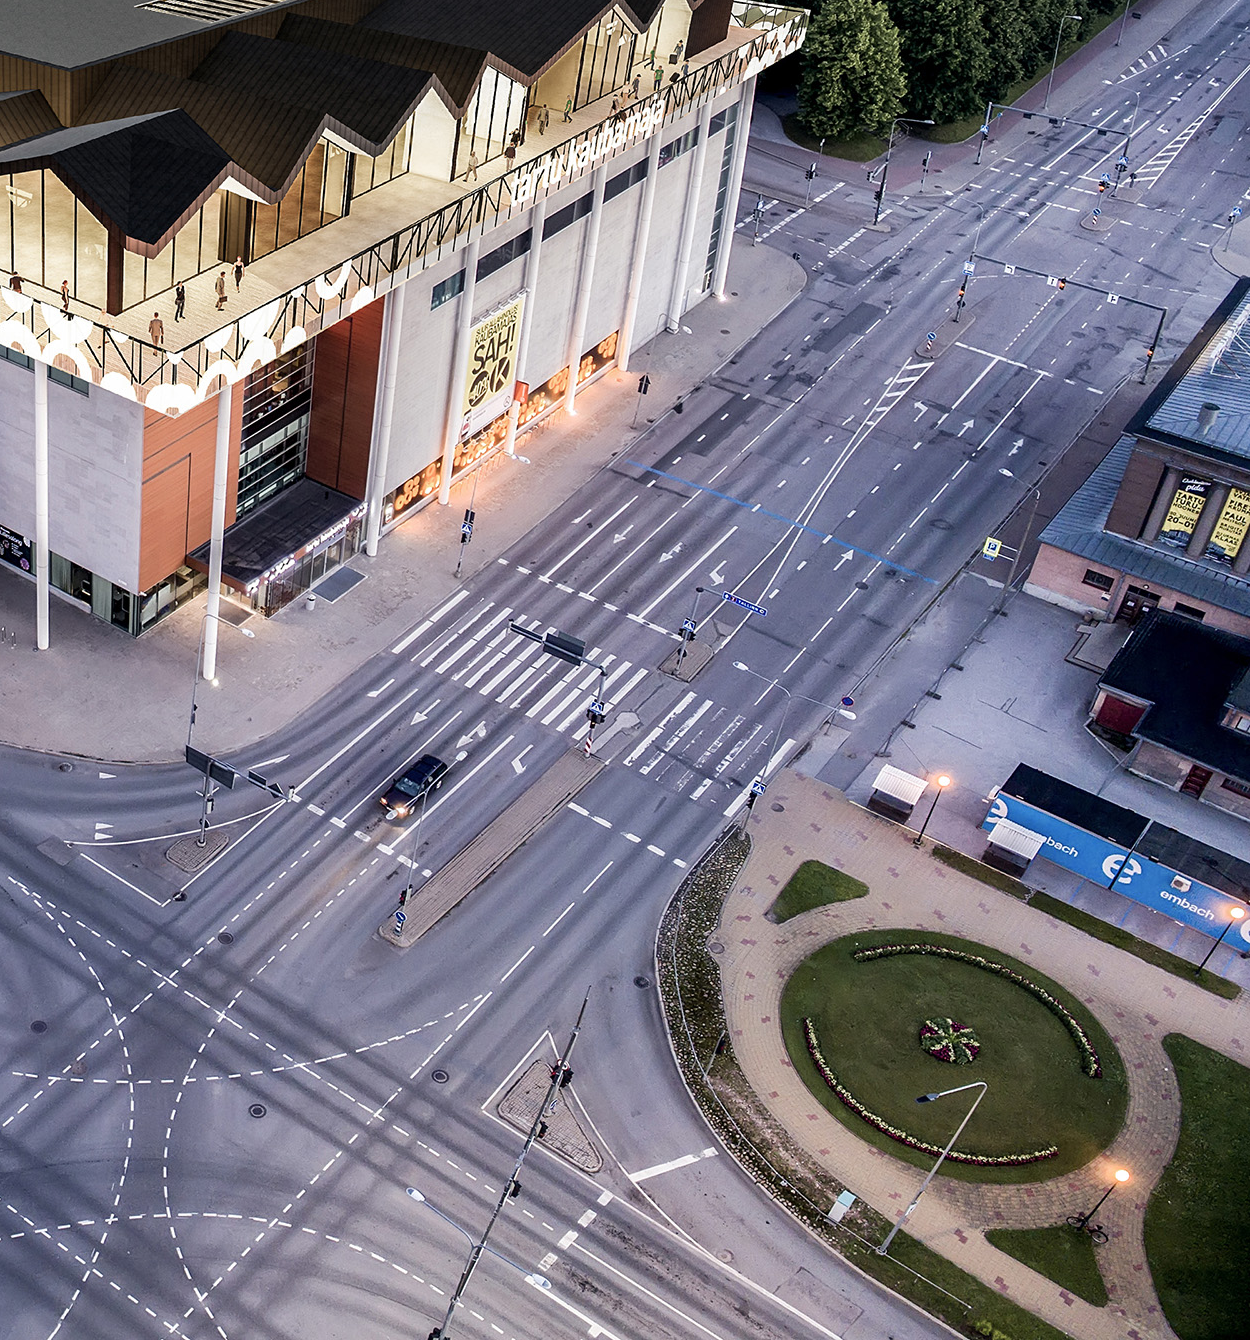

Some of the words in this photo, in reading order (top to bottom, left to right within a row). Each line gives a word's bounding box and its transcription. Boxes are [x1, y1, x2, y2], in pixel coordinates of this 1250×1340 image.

[510, 154, 563, 208] tartu
[565, 93, 665, 177] kaubamaja
[472, 323, 516, 374] SAH!
[1175, 497, 1201, 511] TURU-
[1177, 491, 1204, 506] TARTU
[1224, 512, 1246, 524] PAUL
[1160, 890, 1215, 921] embach
